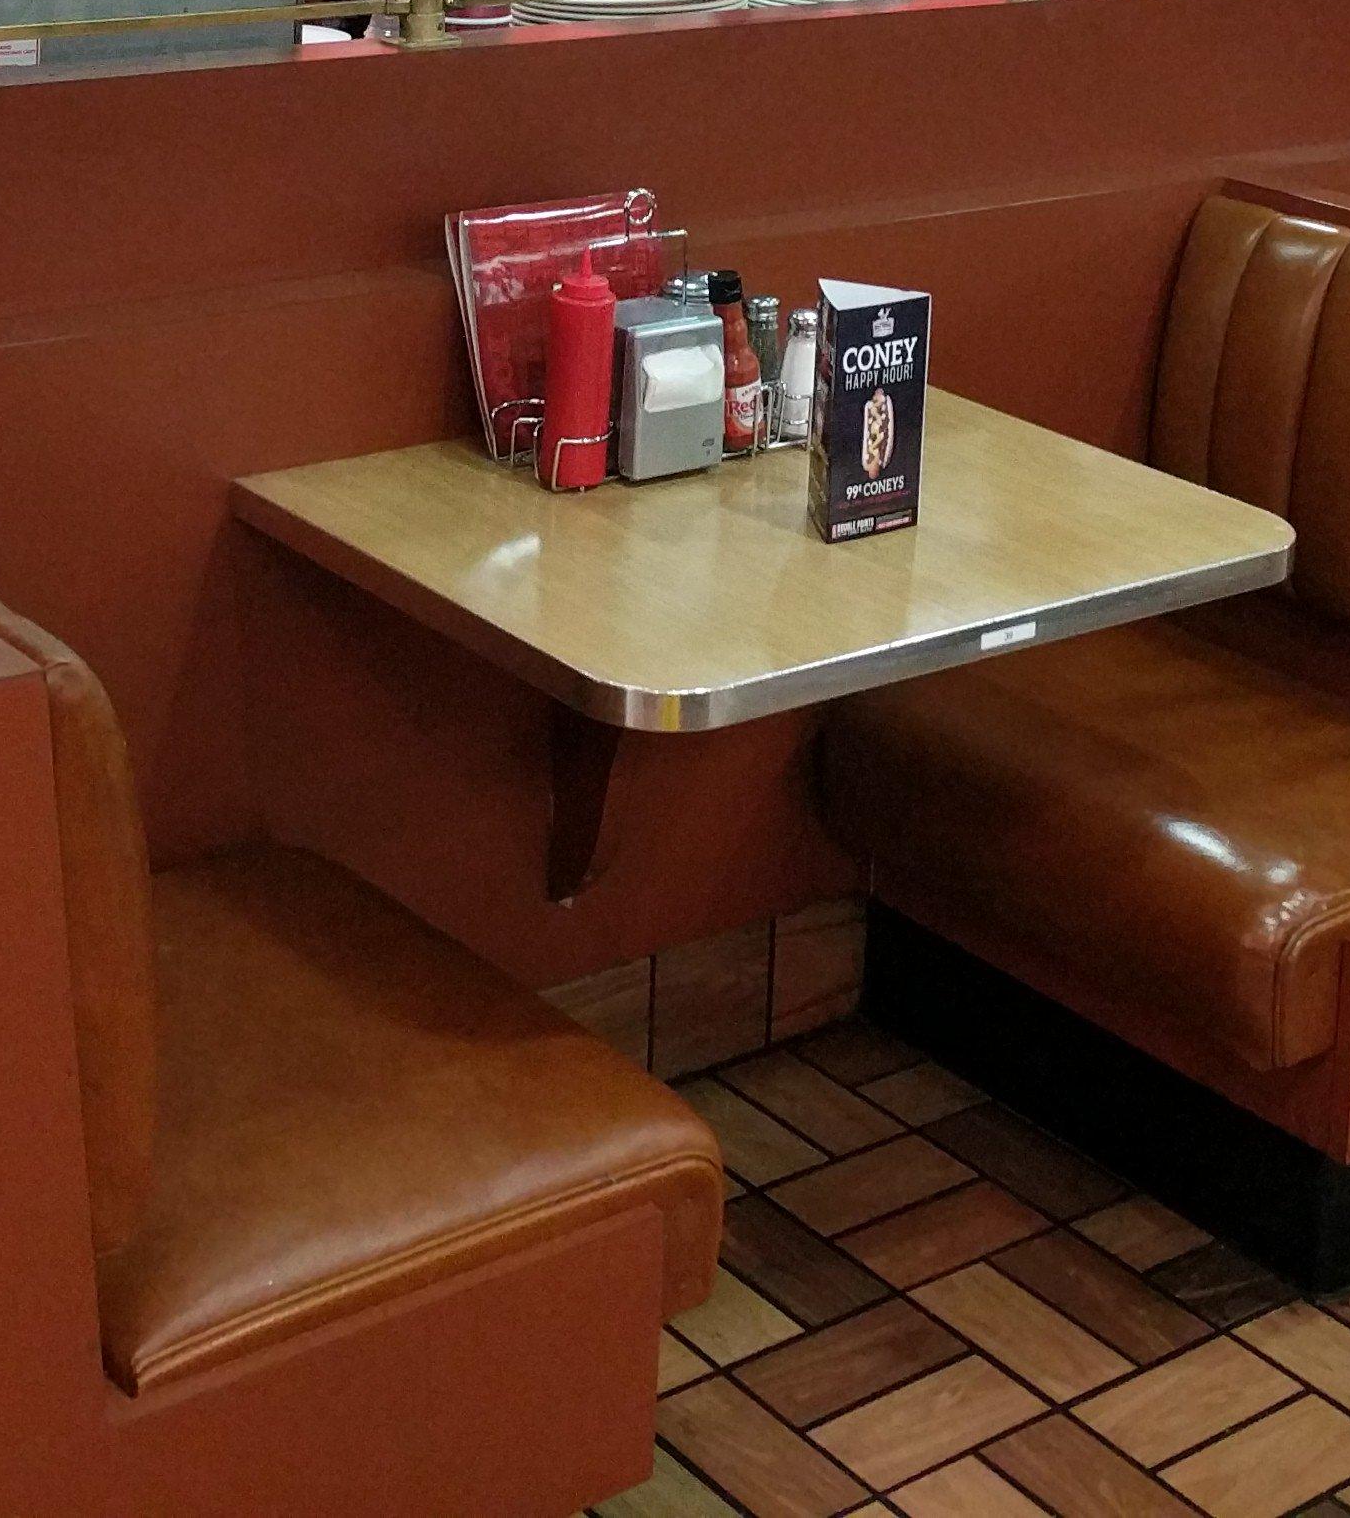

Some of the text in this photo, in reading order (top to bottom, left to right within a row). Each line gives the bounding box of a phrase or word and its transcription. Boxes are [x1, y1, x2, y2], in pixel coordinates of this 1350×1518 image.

[842, 336, 918, 374] CONEY
[845, 363, 914, 391] HAPPY HOUR!
[863, 475, 905, 497] CONEYS
